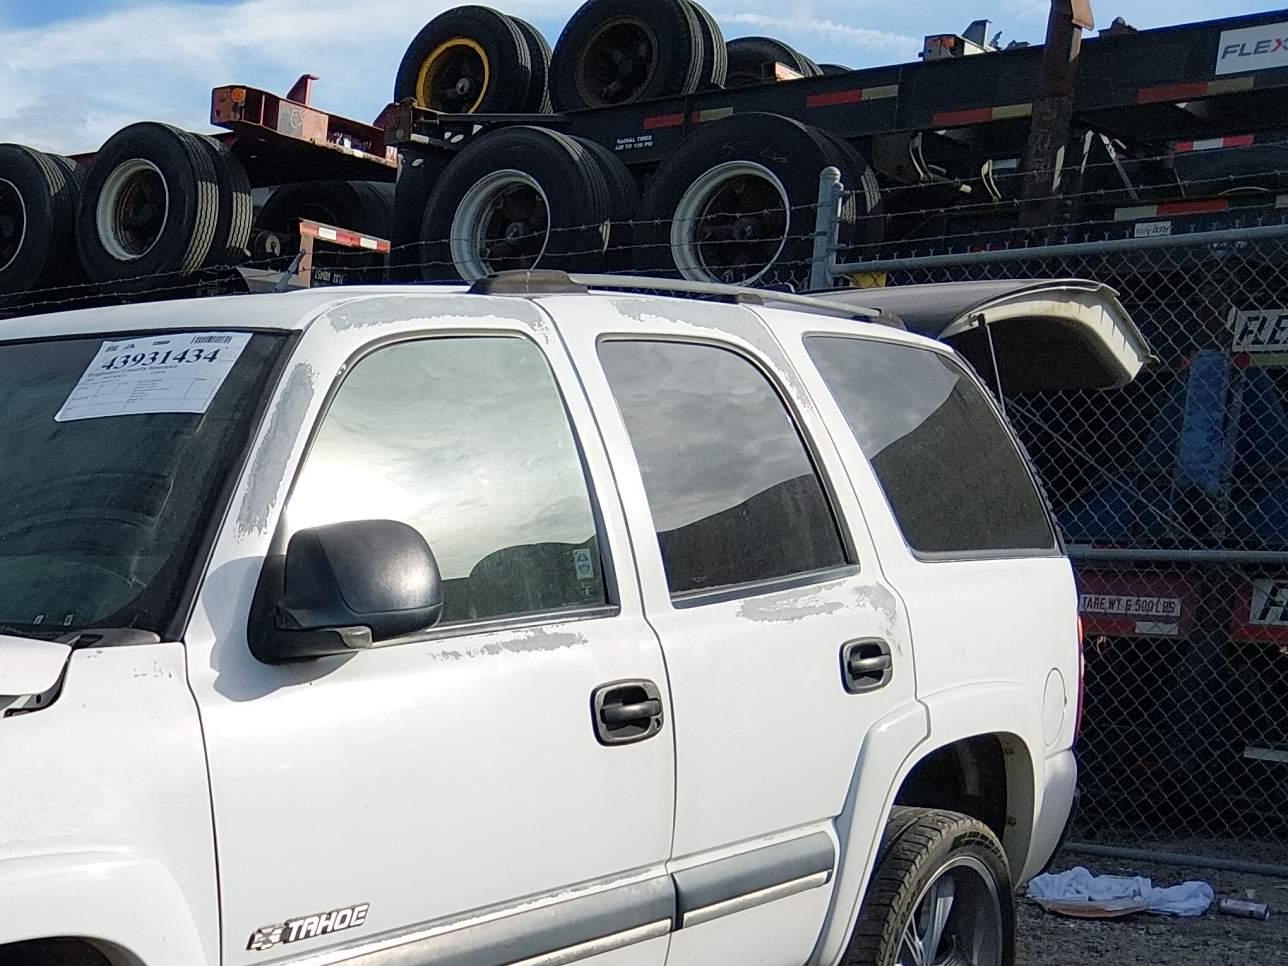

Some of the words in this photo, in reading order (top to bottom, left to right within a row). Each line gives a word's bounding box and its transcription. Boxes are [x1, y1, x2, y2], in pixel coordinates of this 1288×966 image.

[101, 348, 221, 370] 43931434
[1083, 596, 1105, 610] TARE
[285, 903, 369, 942] TAHOE
